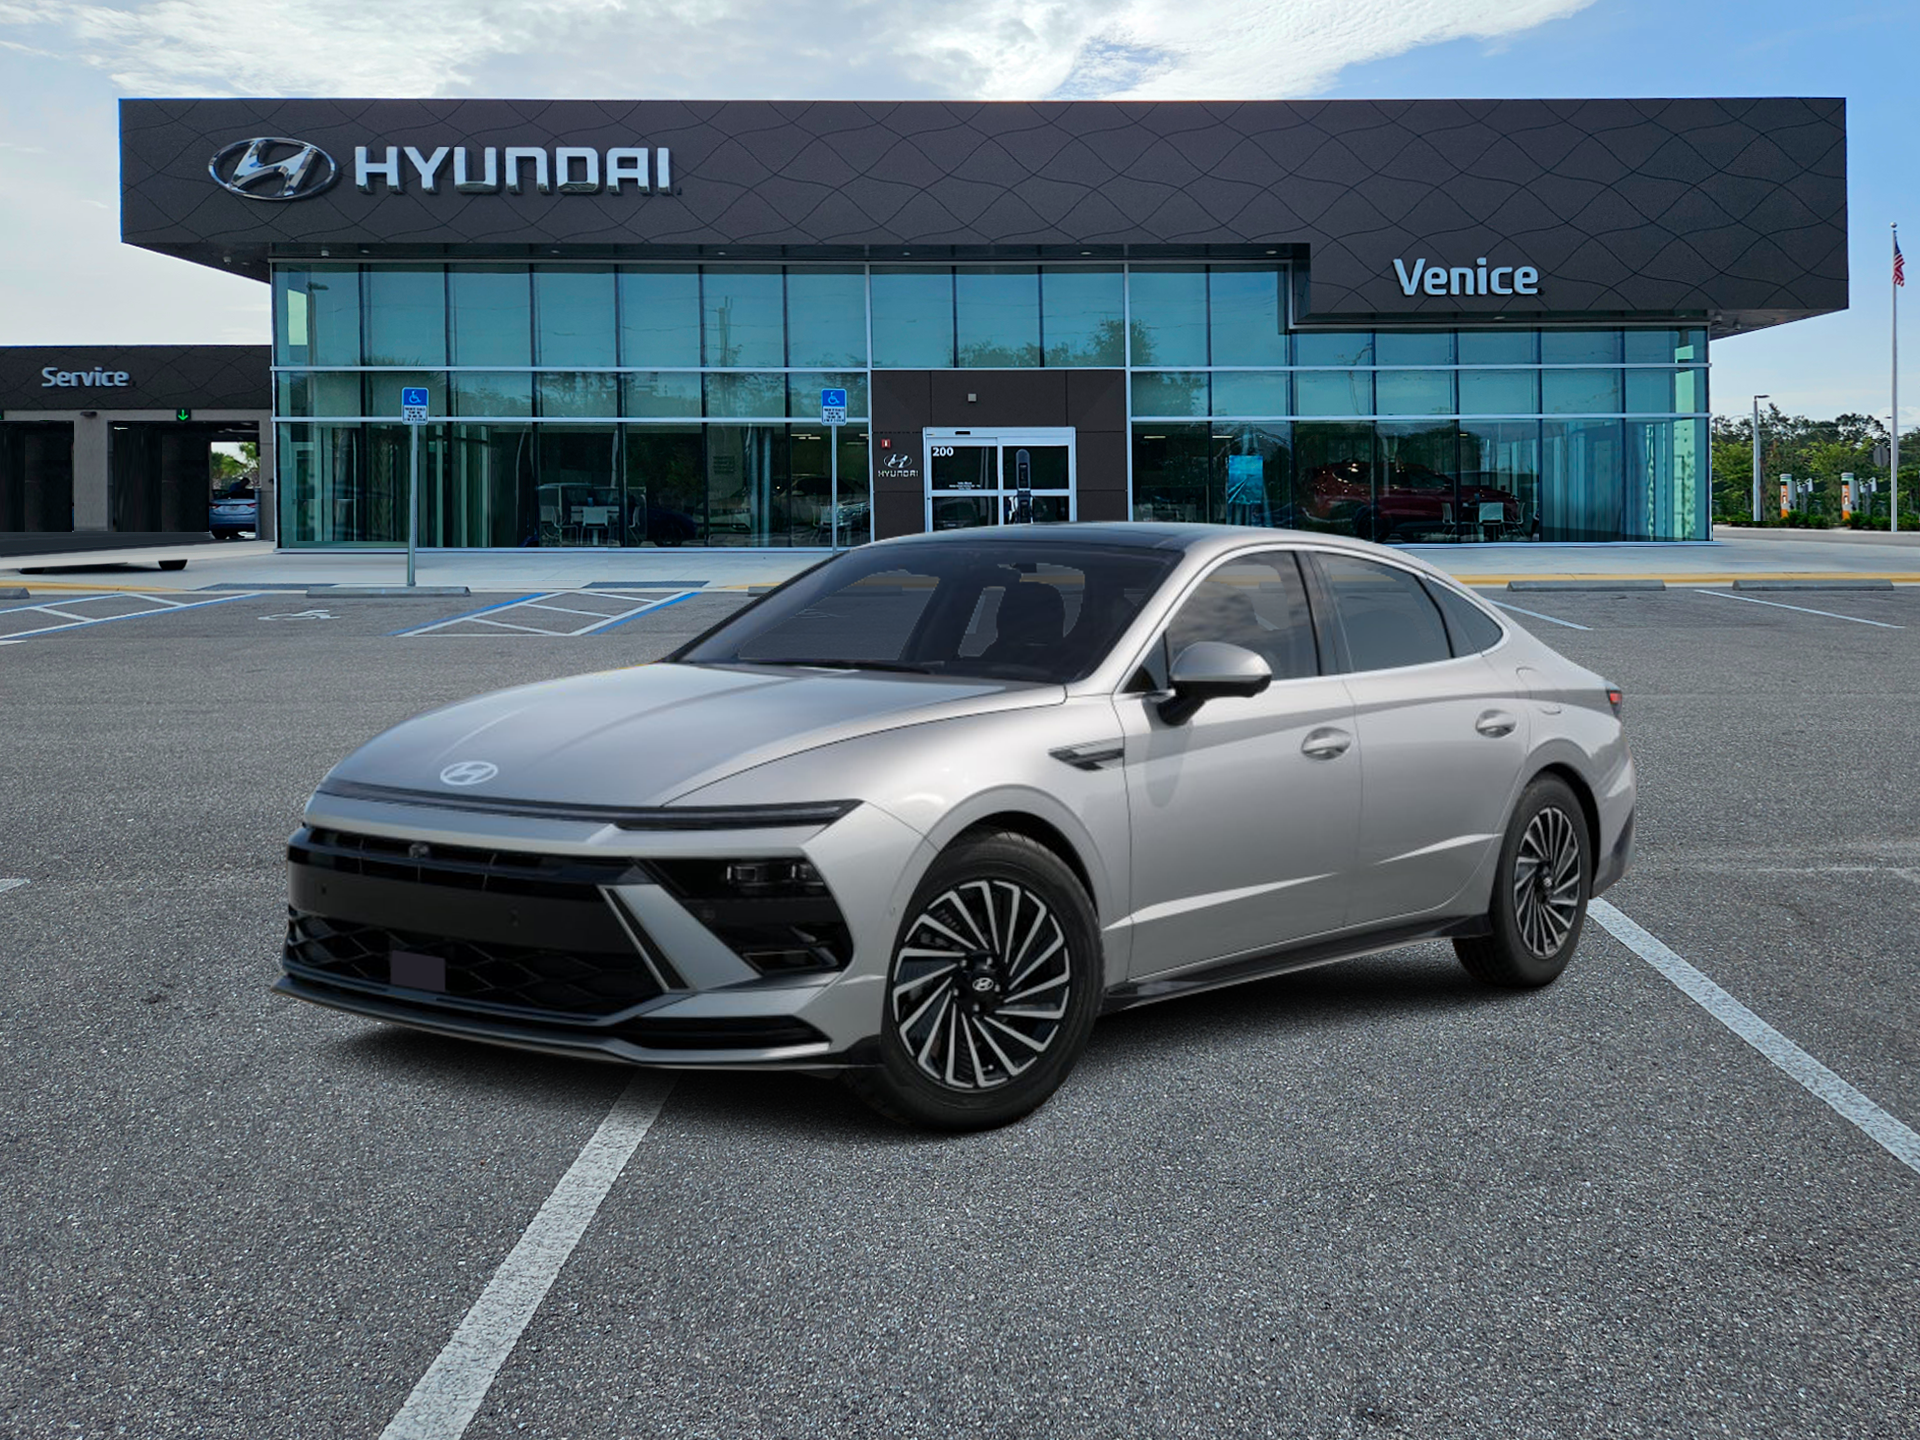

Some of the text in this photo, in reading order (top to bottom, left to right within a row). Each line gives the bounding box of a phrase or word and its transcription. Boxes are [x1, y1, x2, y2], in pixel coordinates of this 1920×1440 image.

[354, 146, 671, 193] HYUNDAI
[1393, 257, 1539, 296] Venice
[41, 366, 130, 387] Service
[932, 447, 954, 457] 200
[877, 470, 919, 478] HYUNDAI
